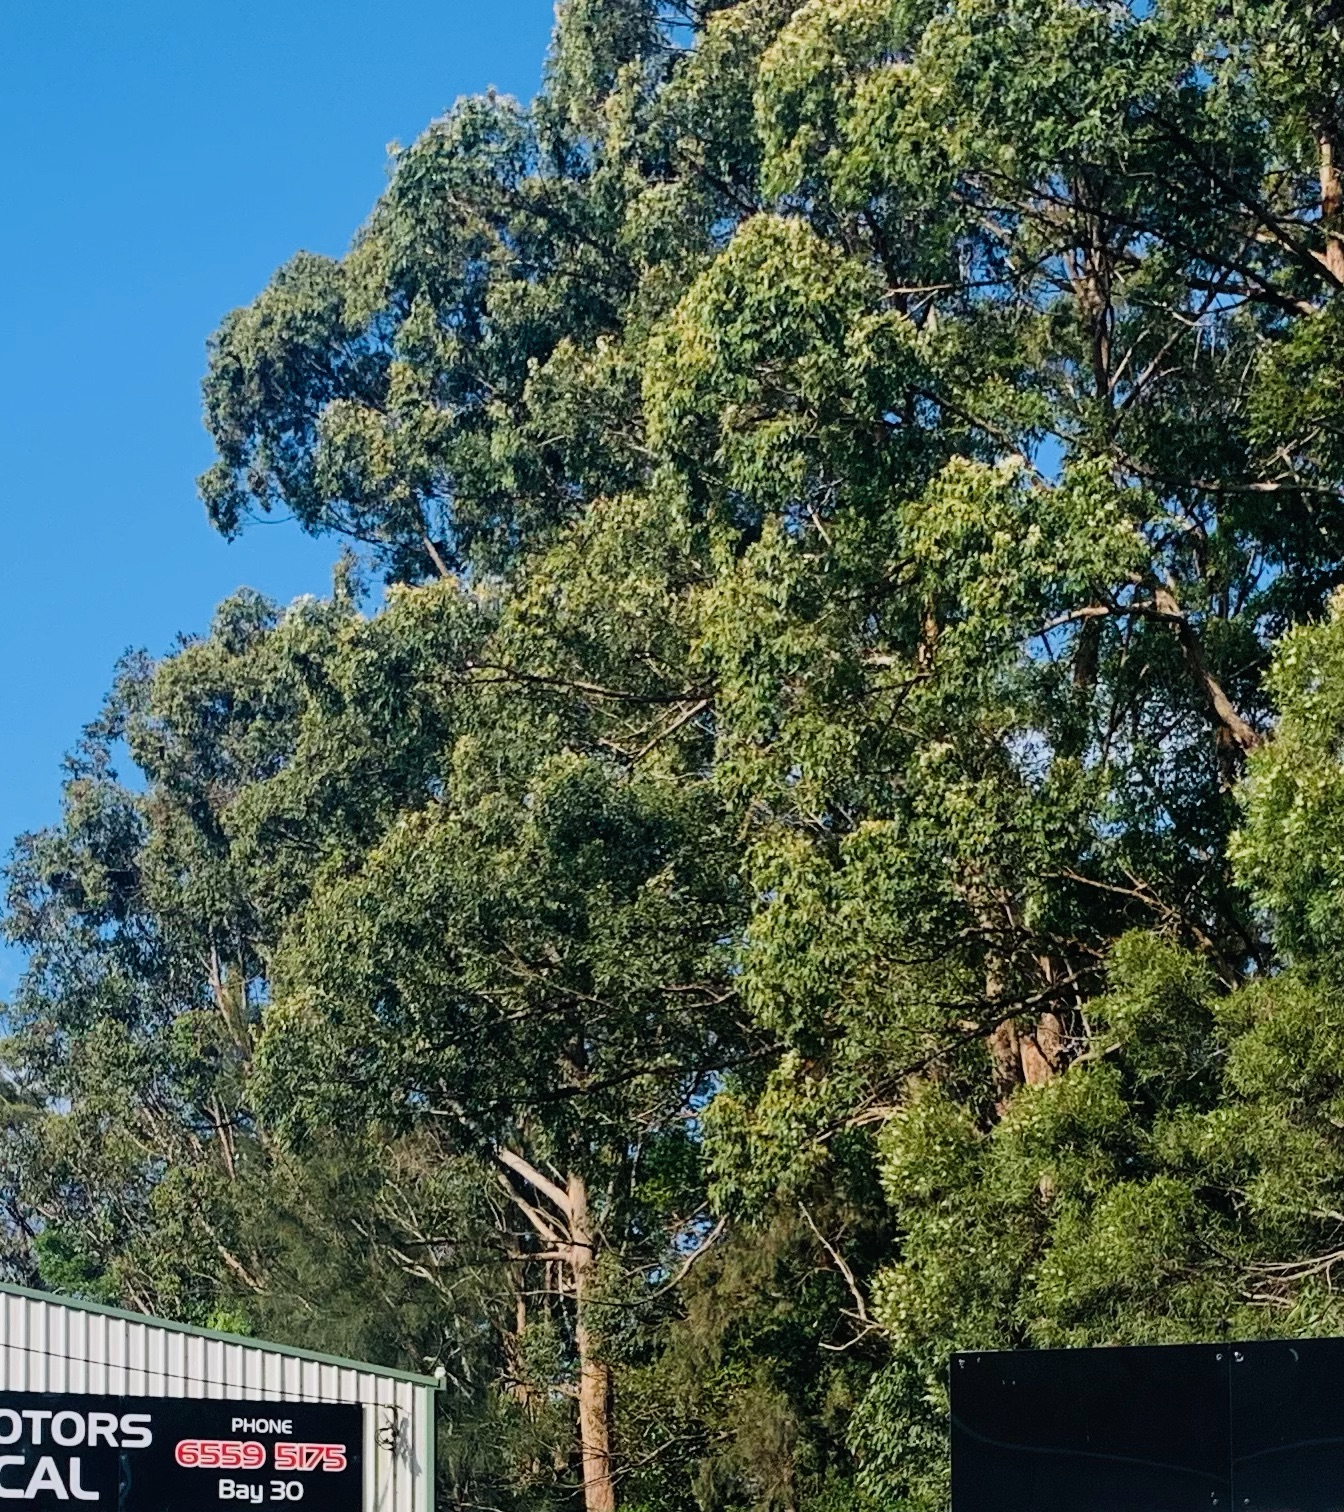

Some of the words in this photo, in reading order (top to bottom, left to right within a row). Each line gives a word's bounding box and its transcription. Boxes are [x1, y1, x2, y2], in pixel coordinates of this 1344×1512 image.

[232, 1418, 292, 1434] PHONE
[175, 1440, 266, 1469] 6559
[275, 1442, 346, 1471] 5175
[219, 1479, 263, 1503] Bay
[270, 1481, 303, 1500] 30
